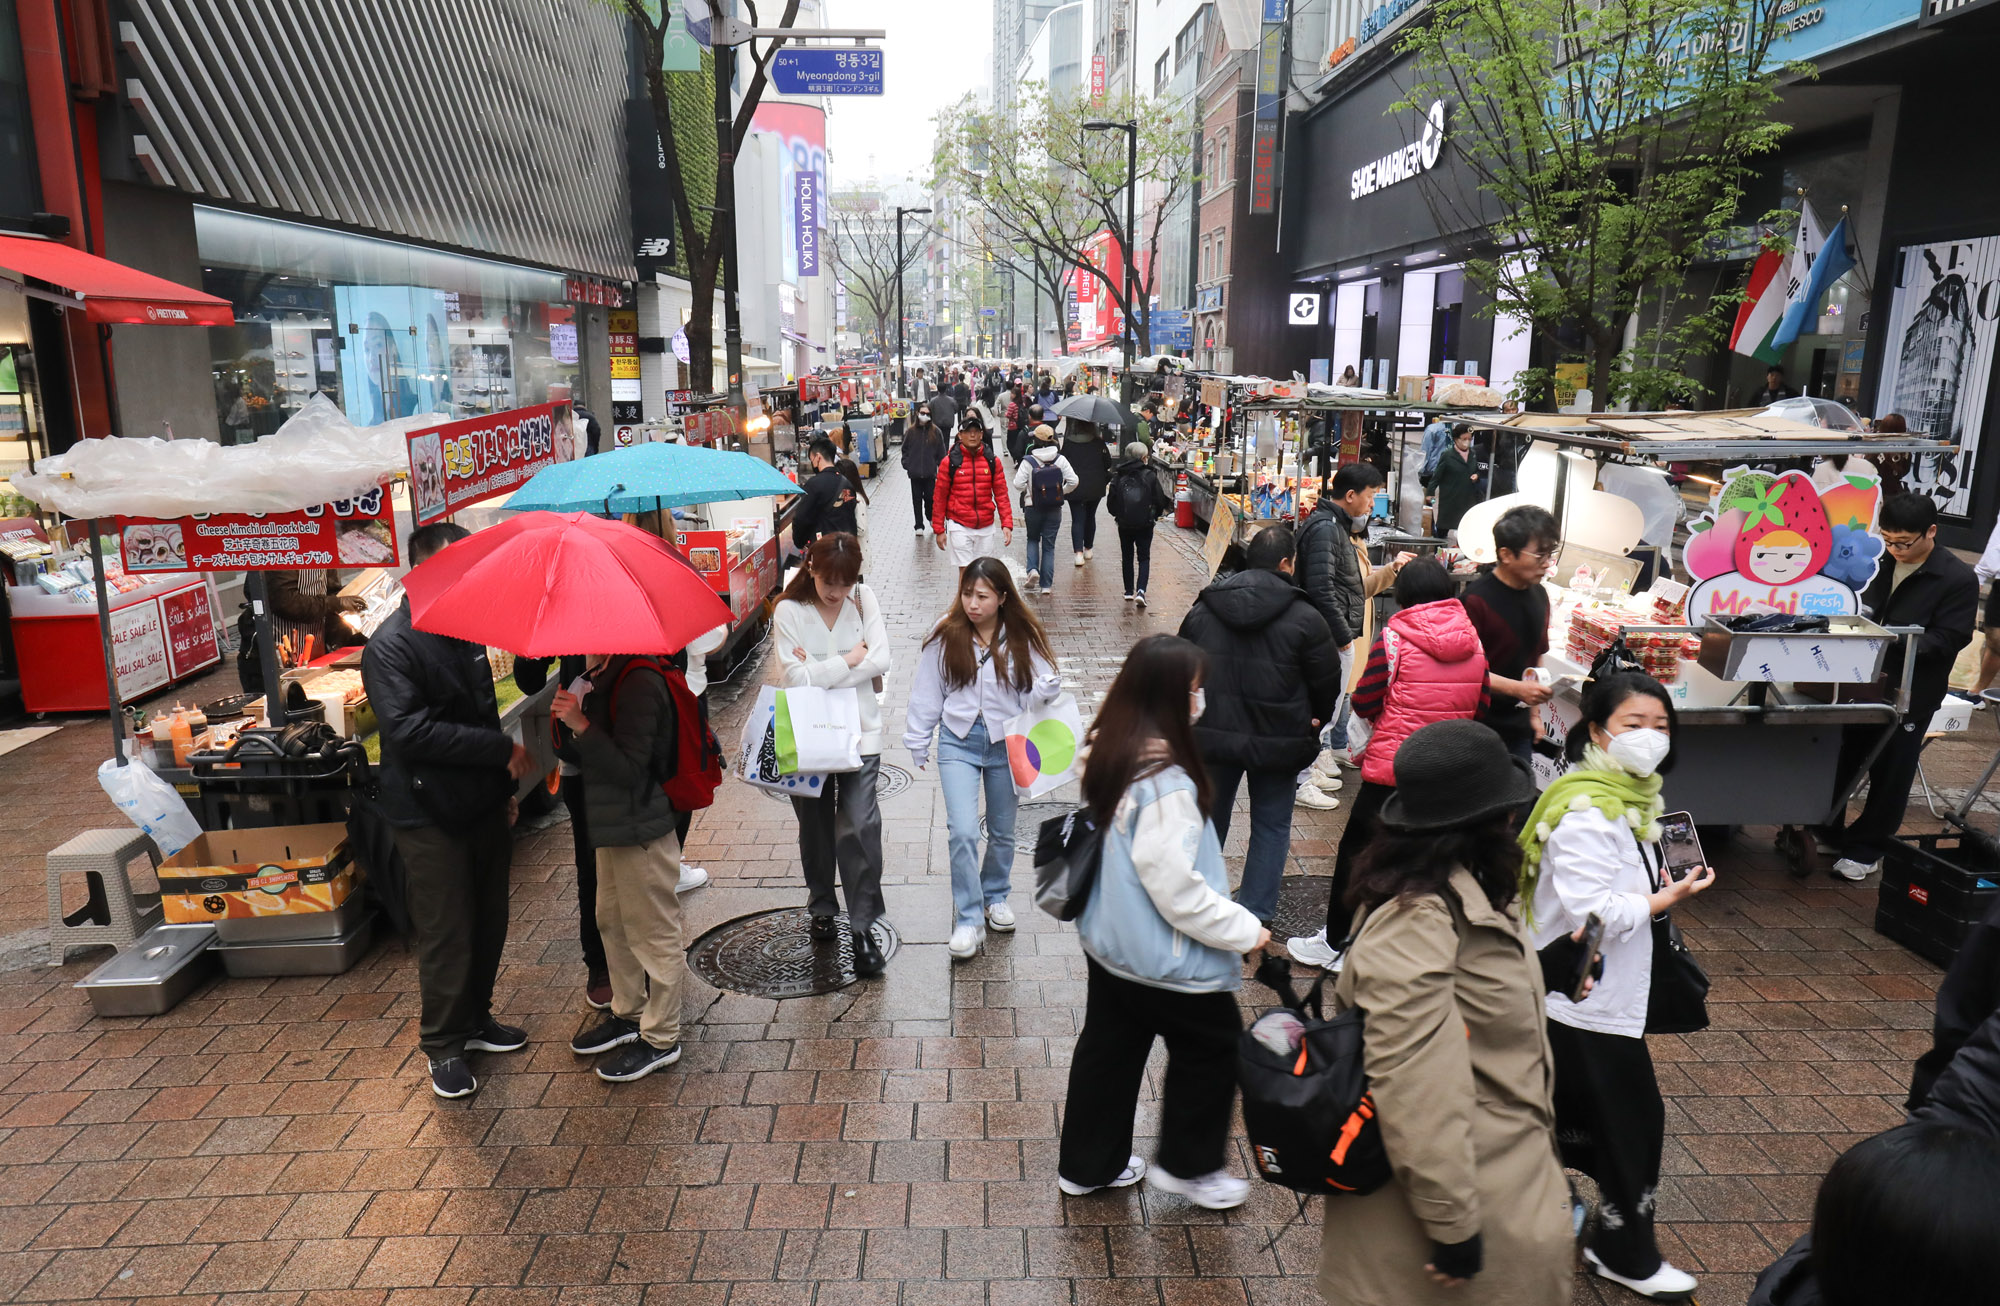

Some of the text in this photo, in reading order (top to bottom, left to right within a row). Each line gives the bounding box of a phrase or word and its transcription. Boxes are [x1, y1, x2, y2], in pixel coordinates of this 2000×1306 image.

[778, 58, 788, 66] 50
[835, 53, 880, 69] 명동3길
[796, 71, 880, 82] Myeongdong 3-gil
[1255, 136, 1275, 209] 산부인과
[1350, 140, 1421, 200] SHOE MARKER
[800, 177, 814, 270] HOLIKA HOLIKA
[444, 434, 475, 480] 치즈
[519, 414, 552, 461] 삼겹살
[196, 521, 319, 537] Cheese kimchi roll pork belly
[1803, 594, 1841, 608] Fresh
[169, 612, 185, 627] SALE
[194, 603, 209, 617] SALE
[129, 624, 146, 640] SALE
[174, 638, 191, 653] SALE
[199, 629, 214, 645] SALE
[147, 651, 163, 666] SALE
[269, 872, 295, 884] SUNSHINE
